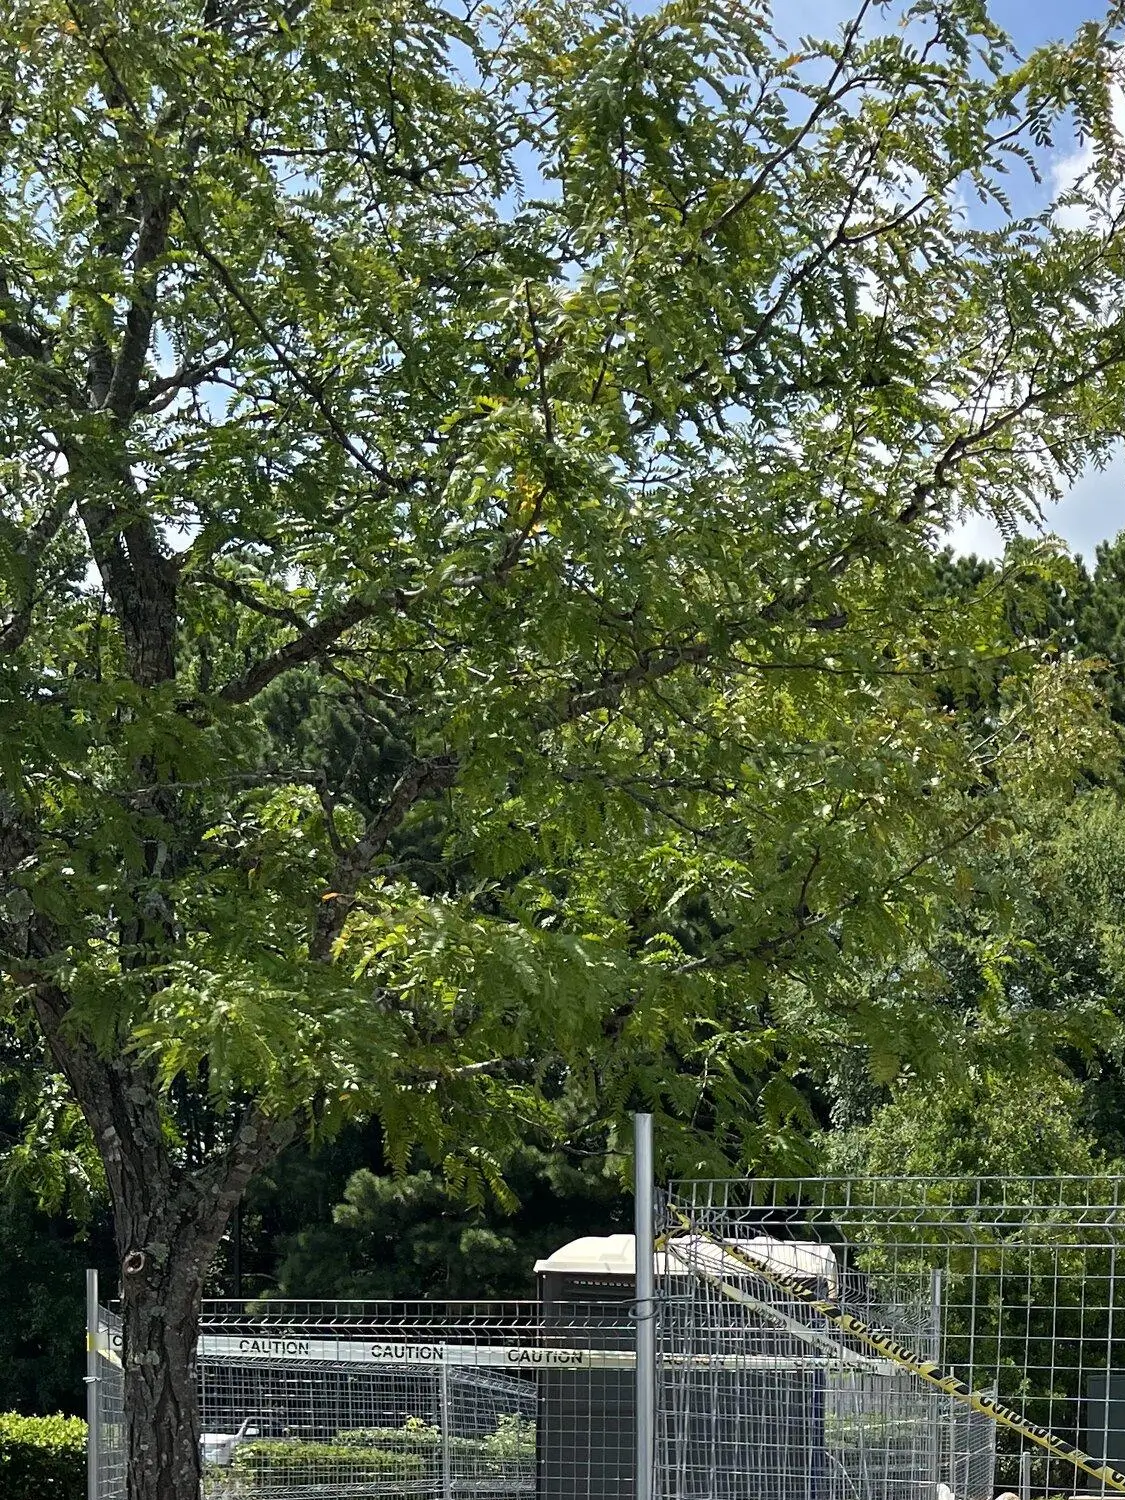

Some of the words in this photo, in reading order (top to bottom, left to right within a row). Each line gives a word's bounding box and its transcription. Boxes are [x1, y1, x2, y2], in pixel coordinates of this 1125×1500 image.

[239, 1339, 309, 1355] CAUTION
[371, 1344, 444, 1360] CAUTION
[507, 1348, 583, 1364] CAUTION
